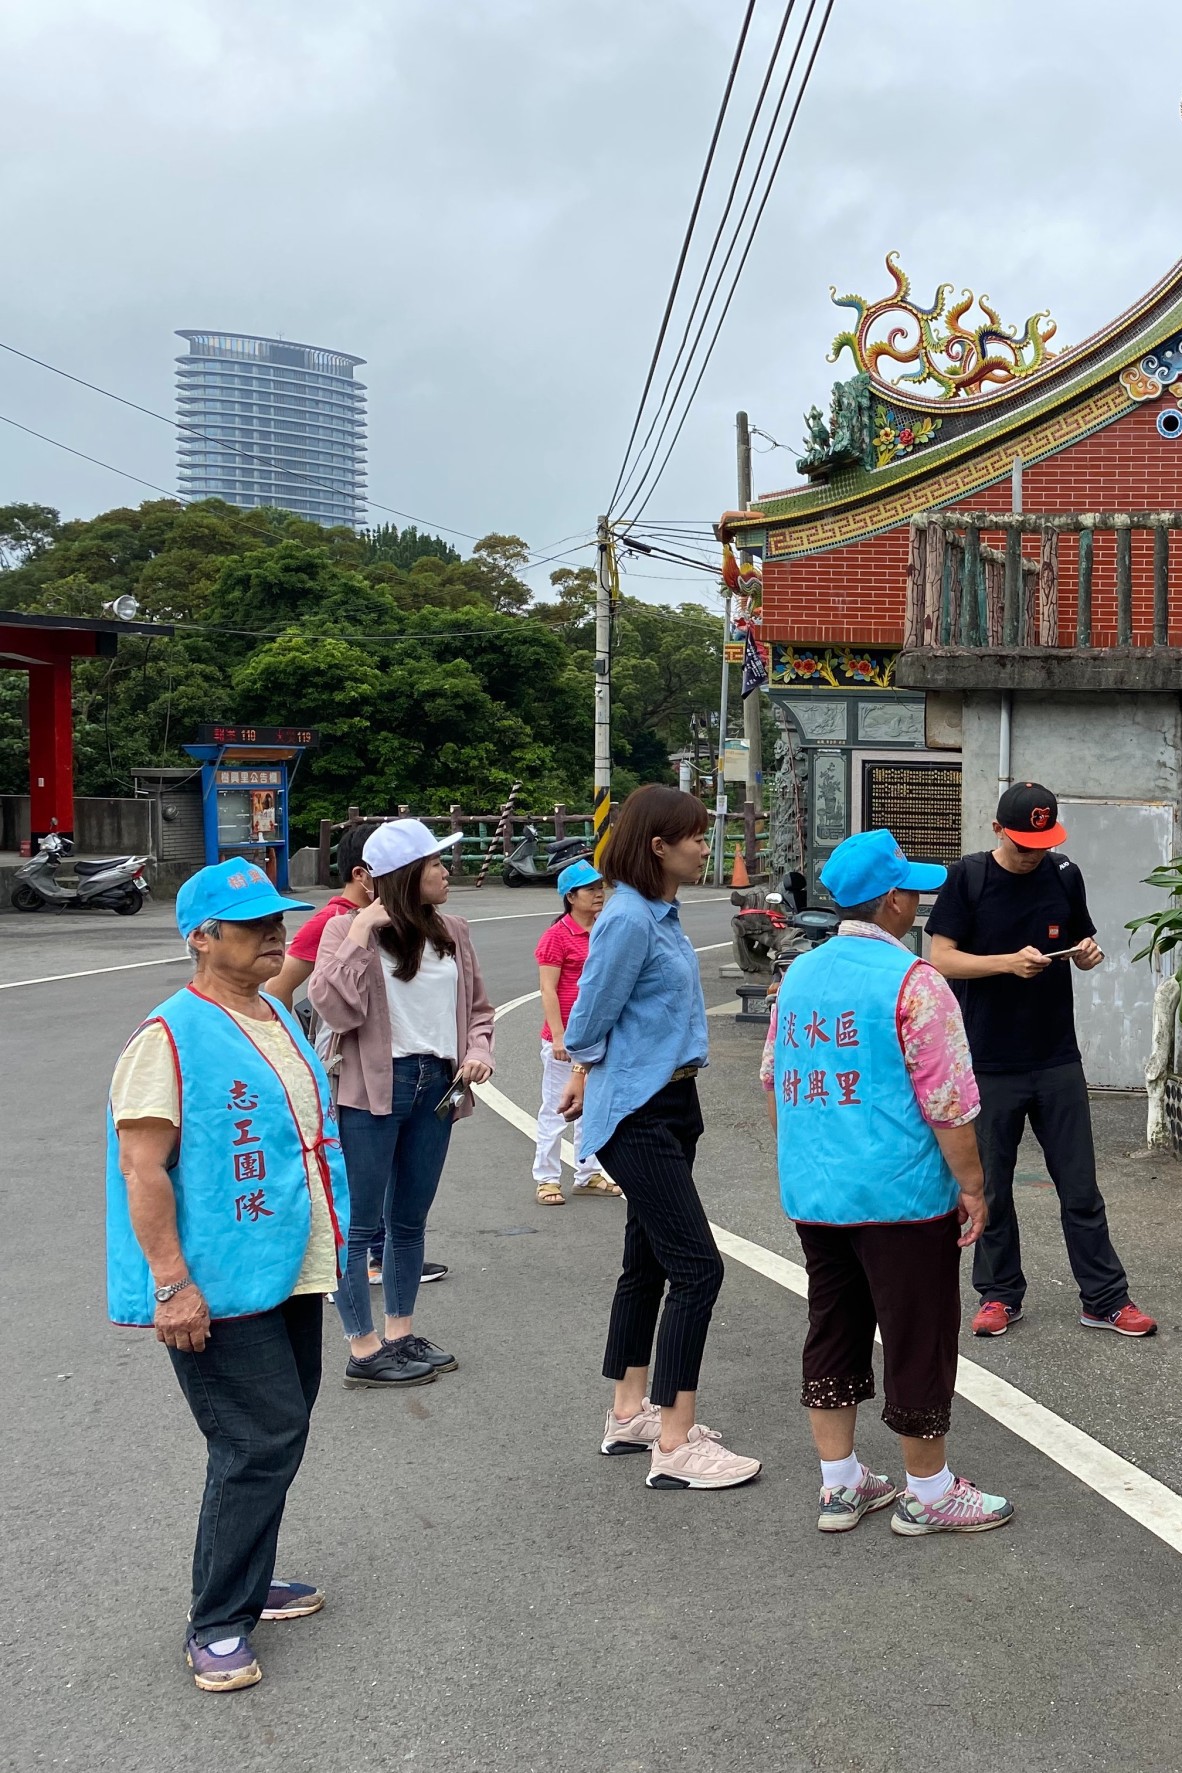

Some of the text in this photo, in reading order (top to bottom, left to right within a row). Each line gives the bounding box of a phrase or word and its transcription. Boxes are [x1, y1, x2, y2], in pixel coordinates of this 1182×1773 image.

[241, 729, 256, 741] 110
[297, 731, 311, 743] 119
[782, 1009, 861, 1049] 淡水區
[782, 1068, 862, 1107] 樹興里
[226, 1079, 275, 1223] 志工團隊
